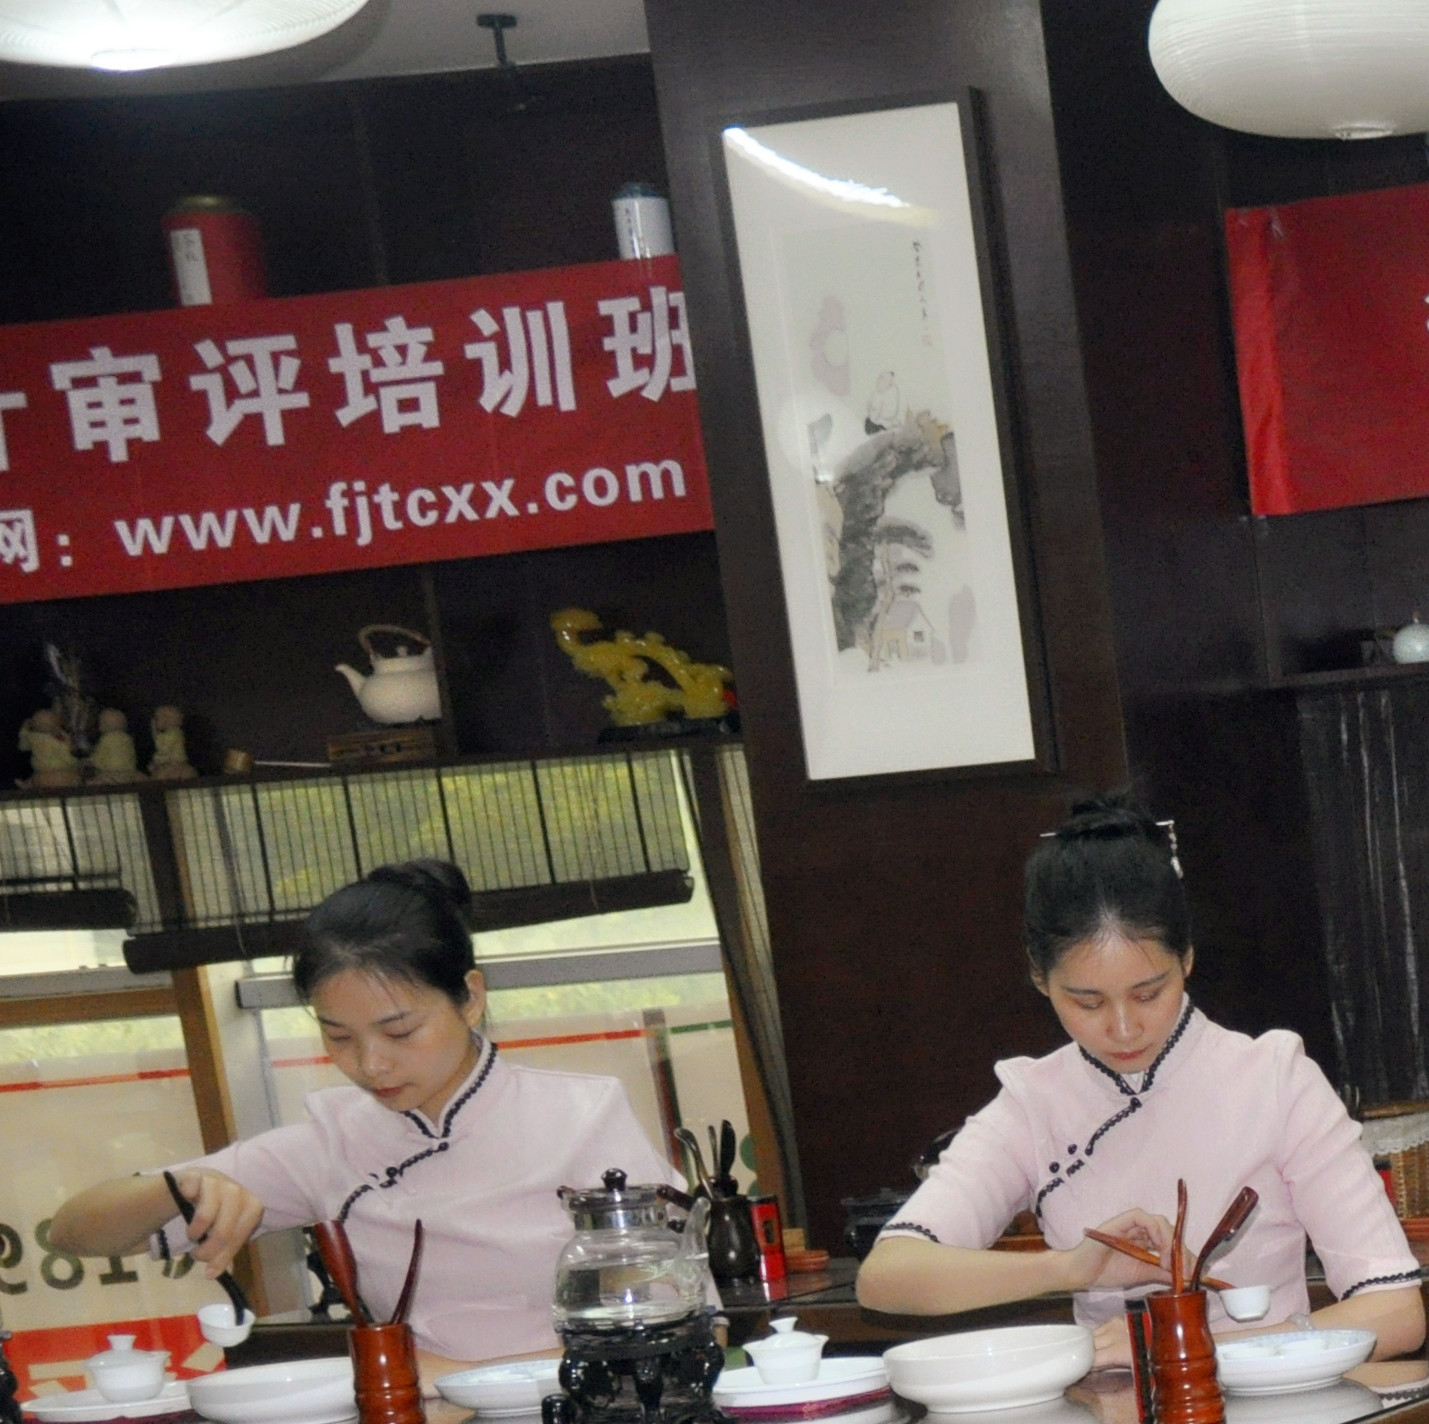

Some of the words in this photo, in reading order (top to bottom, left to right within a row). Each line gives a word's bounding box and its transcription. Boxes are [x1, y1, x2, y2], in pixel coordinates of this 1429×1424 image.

[0, 286, 695, 472] 审评培训班
[114, 459, 686, 556] www.fjtcxx.com
